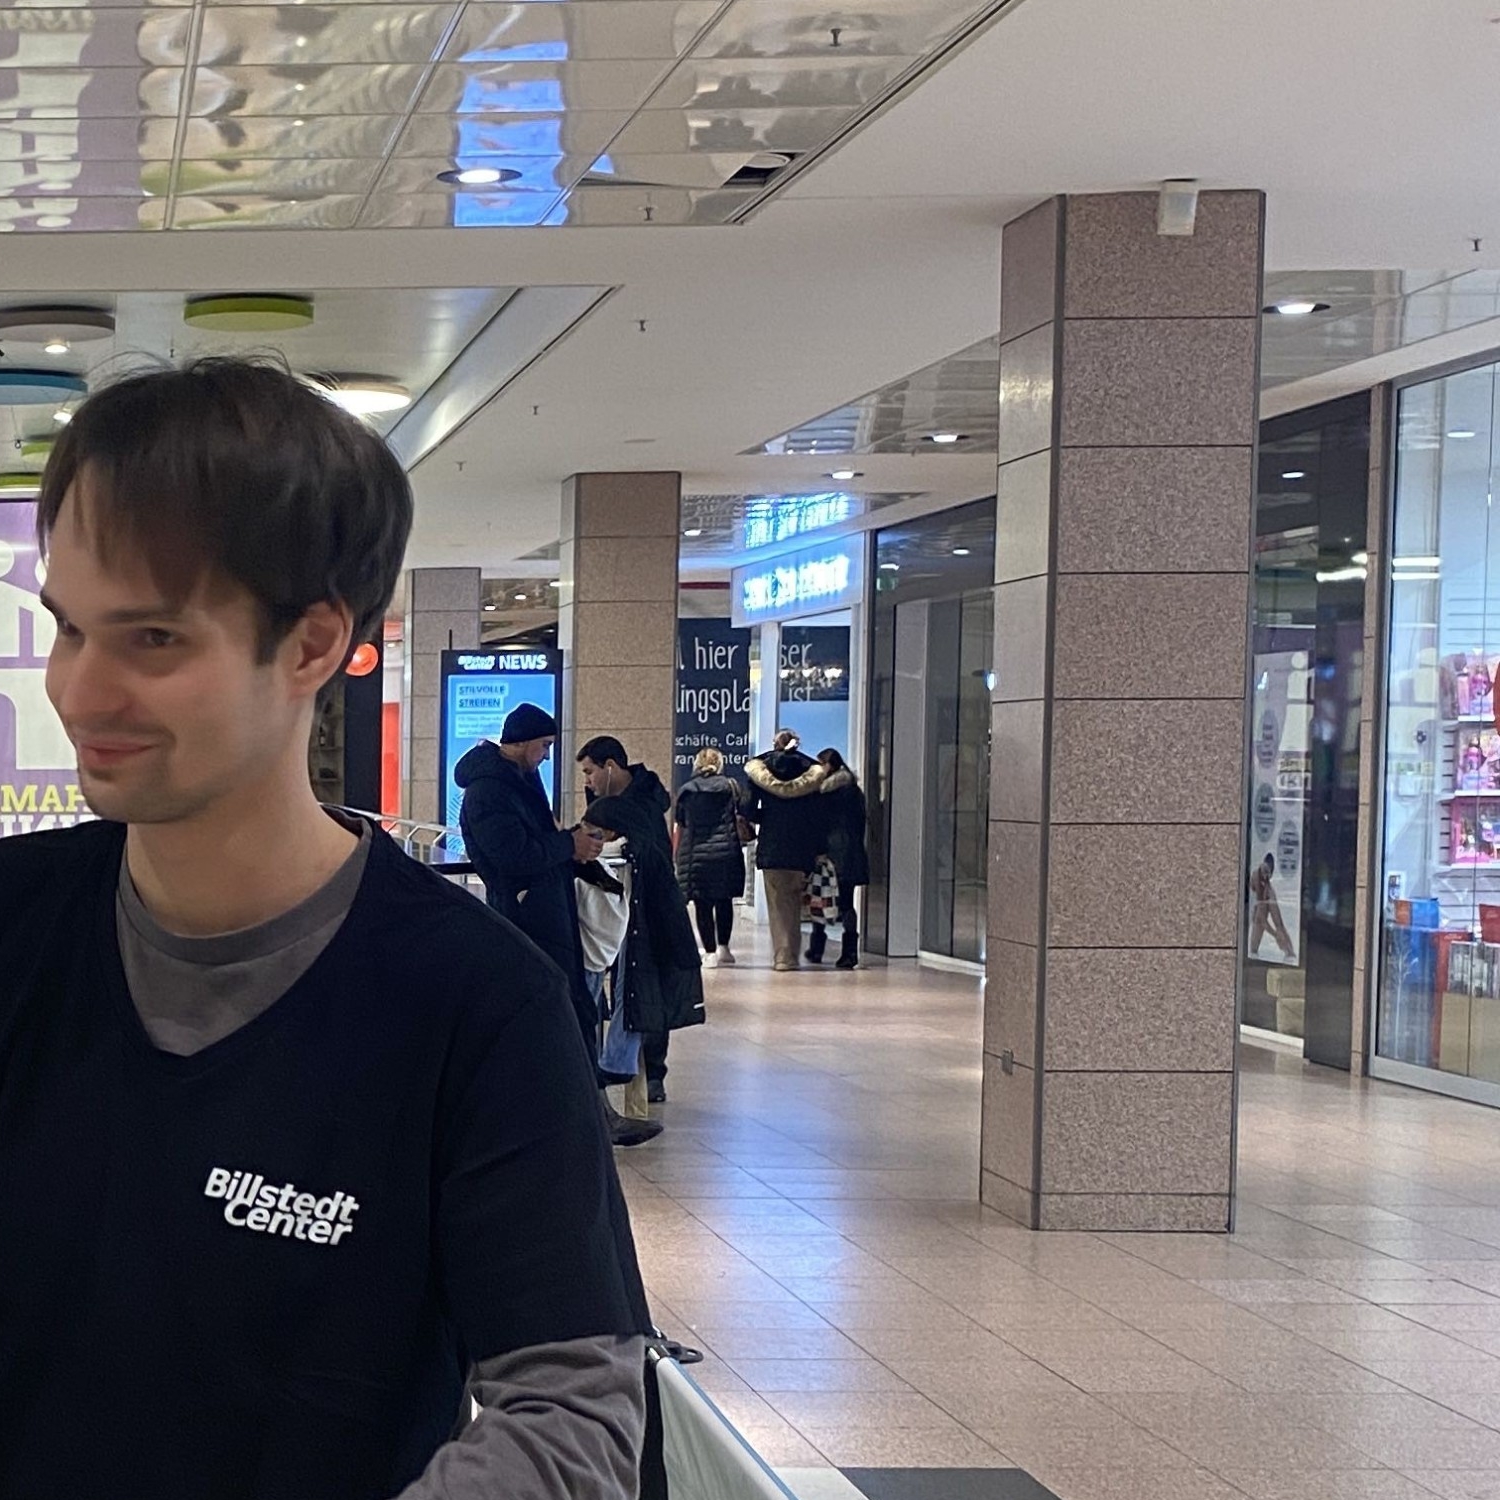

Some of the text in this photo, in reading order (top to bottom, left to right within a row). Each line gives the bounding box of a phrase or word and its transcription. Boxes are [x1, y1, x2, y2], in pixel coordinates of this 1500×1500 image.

[499, 654, 548, 670] NEWS
[695, 637, 739, 670] hier
[459, 686, 505, 695] STILVOLLE
[459, 698, 500, 708] STREIFEN
[204, 1167, 360, 1224] Billstedt
[224, 1198, 354, 1246] Center
